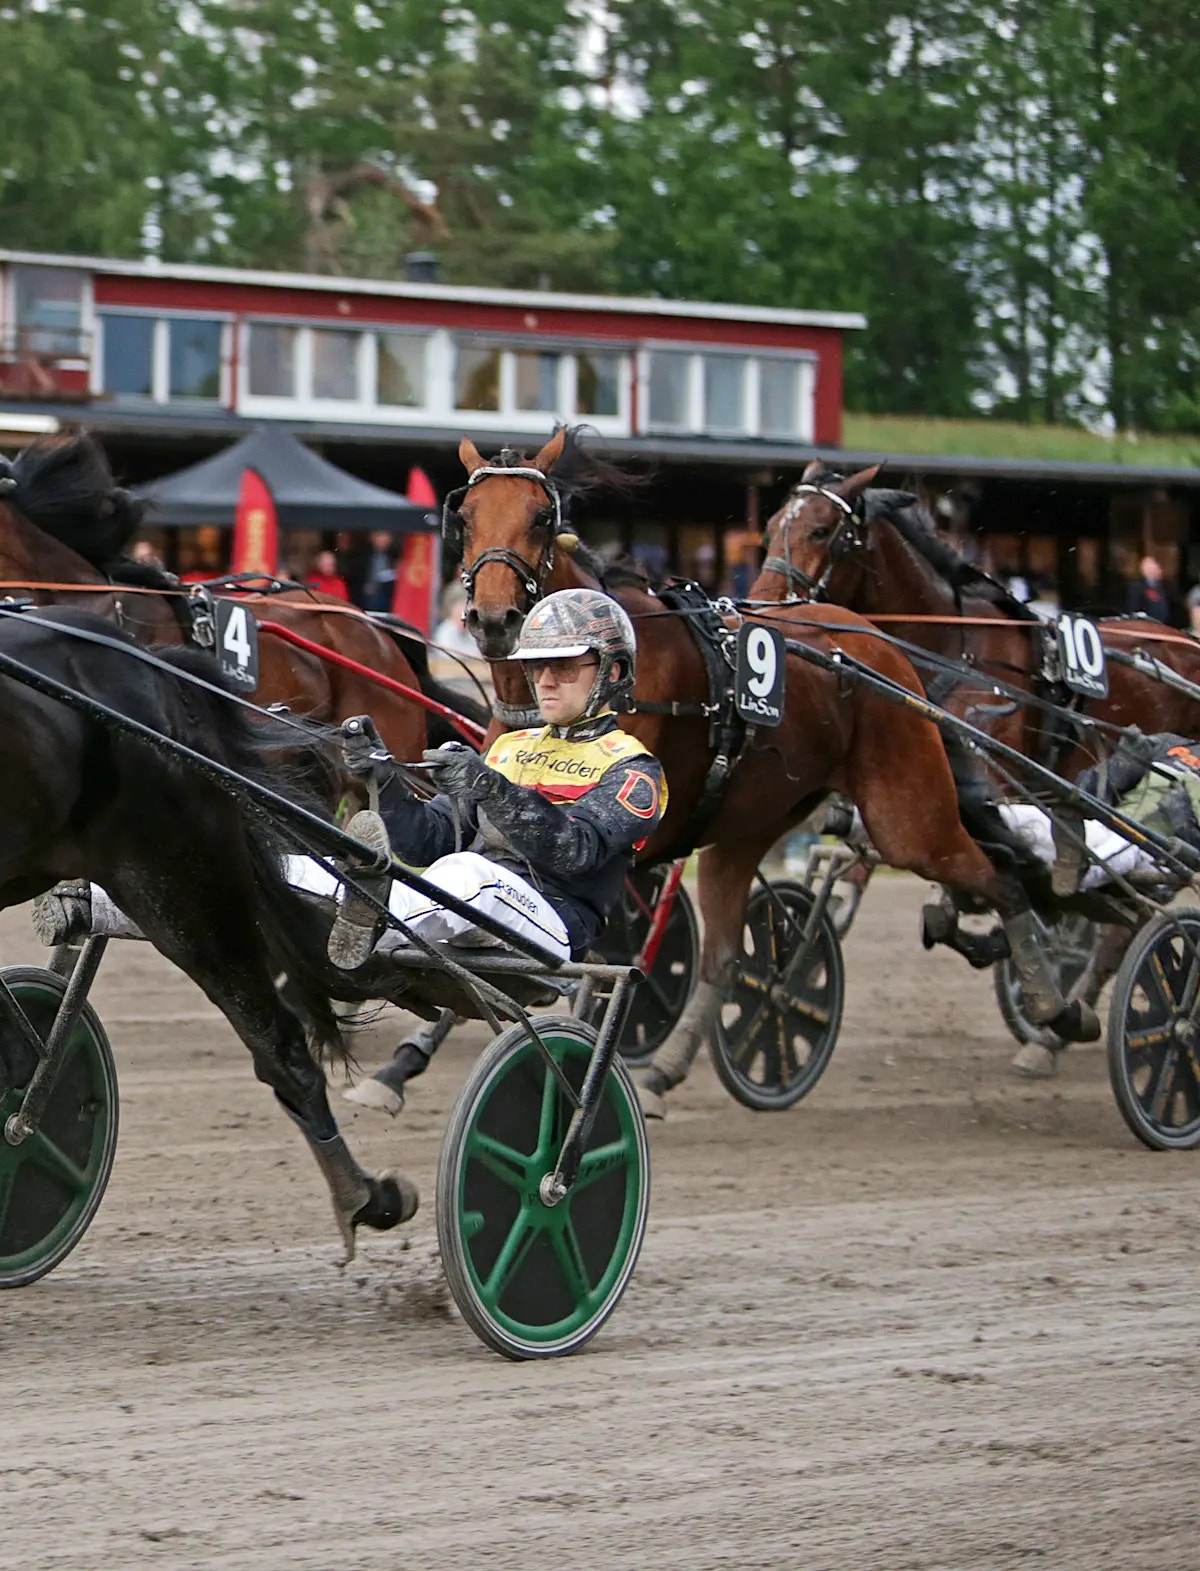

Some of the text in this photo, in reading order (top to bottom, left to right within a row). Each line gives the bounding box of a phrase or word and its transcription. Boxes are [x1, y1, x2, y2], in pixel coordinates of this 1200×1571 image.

[223, 606, 251, 667] 4
[746, 627, 776, 697] 9
[1058, 614, 1103, 677] 10
[740, 693, 780, 718] LinSon
[616, 768, 658, 819] D
